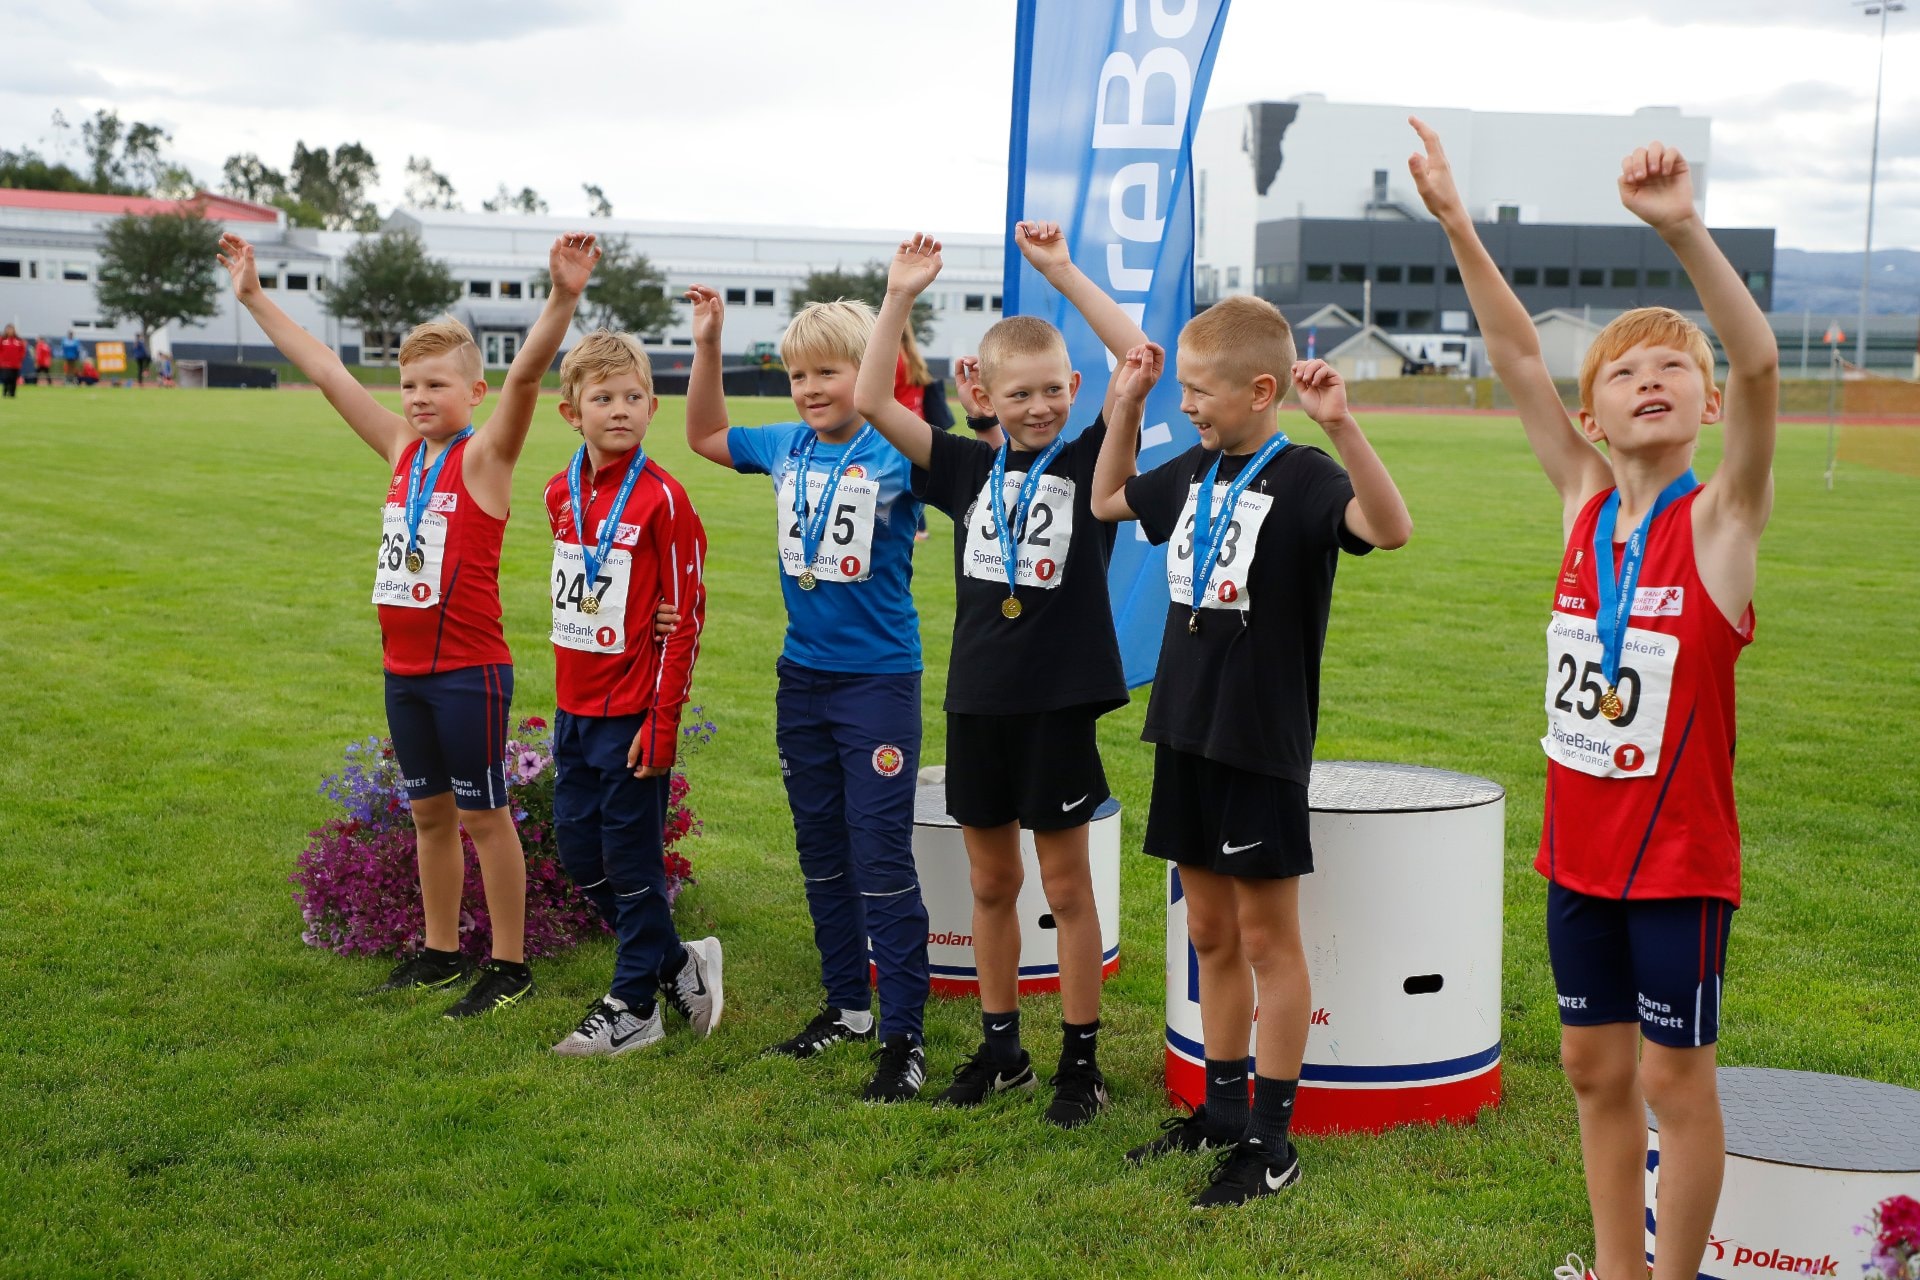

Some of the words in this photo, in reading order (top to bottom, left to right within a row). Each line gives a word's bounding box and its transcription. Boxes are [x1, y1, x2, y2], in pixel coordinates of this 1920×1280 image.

[1091, 0, 1198, 541] reBa
[1236, 498, 1263, 512] kene
[789, 500, 856, 546] 25
[982, 500, 1053, 546] 302
[1178, 514, 1241, 567] 33
[378, 533, 426, 572] 266
[784, 549, 838, 566] SparBank
[973, 549, 1034, 569] Sparenk
[795, 563, 838, 575] NOR-NORGE
[986, 566, 1033, 578] NORDORGE
[374, 580, 410, 594] reBank
[555, 568, 612, 614] 247
[1168, 570, 1218, 592] Sparenk
[1174, 587, 1215, 602] NORDRGE
[1552, 623, 1601, 645] SpareBan
[1621, 639, 1666, 657] ekene
[1555, 653, 1641, 728] 250
[927, 931, 974, 947] polan
[1638, 992, 1671, 1013] Rana
[1733, 1247, 1840, 1277] polanik
